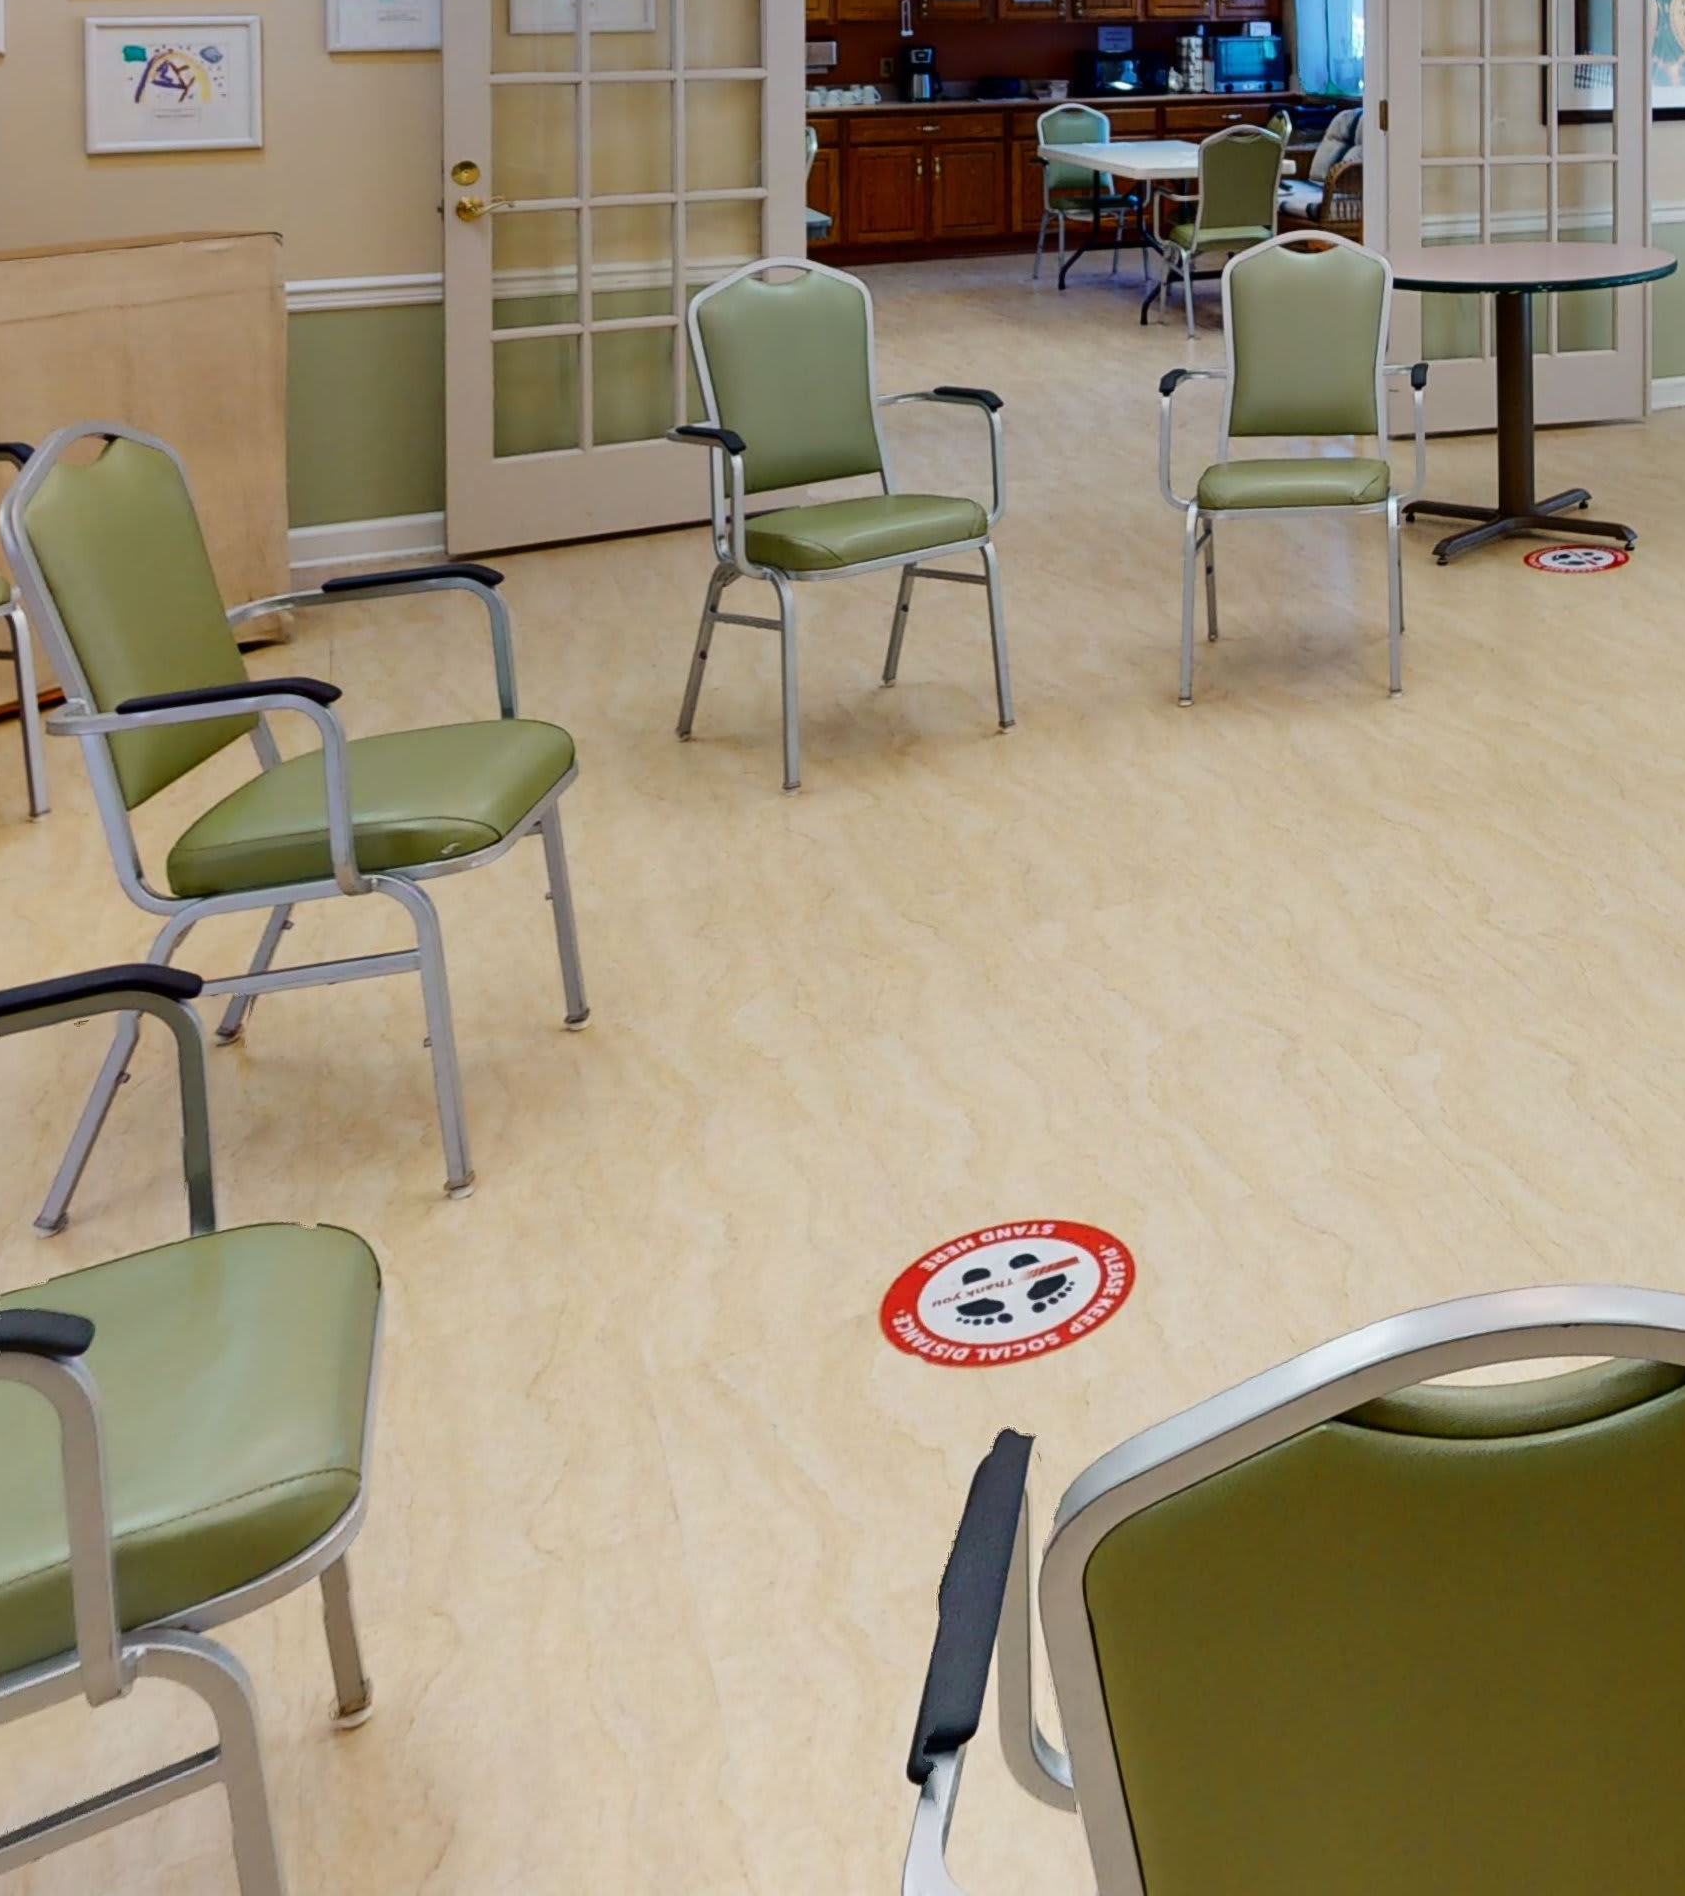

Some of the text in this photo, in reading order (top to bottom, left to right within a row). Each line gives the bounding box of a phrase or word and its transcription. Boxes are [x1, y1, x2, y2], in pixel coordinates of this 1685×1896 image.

[918, 1223, 1056, 1271] STAND HERE
[932, 1278, 1014, 1308] Thank you
[1069, 1297, 1114, 1335] KEEP
[977, 1332, 1061, 1361] SOCIAL
